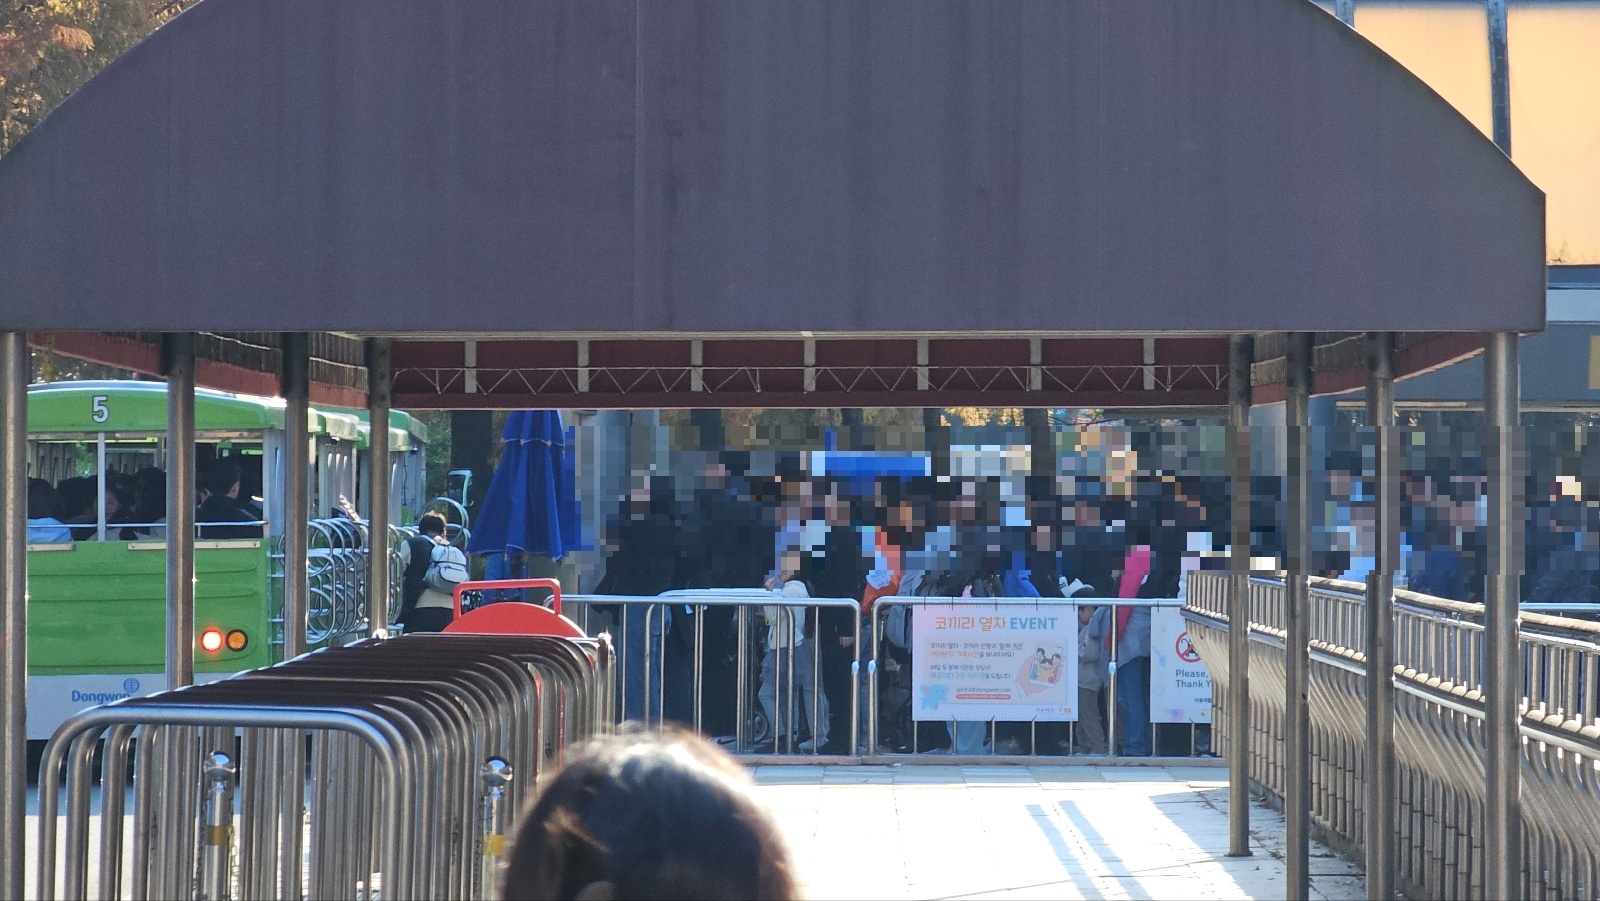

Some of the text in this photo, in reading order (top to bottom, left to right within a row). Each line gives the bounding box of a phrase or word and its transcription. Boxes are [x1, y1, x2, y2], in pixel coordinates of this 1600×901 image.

[92, 395, 109, 423] 5
[935, 616, 1057, 631] 코끼리 열차 EVENT
[1175, 669, 1209, 678] Please,
[1175, 680, 1212, 688] Thank Y
